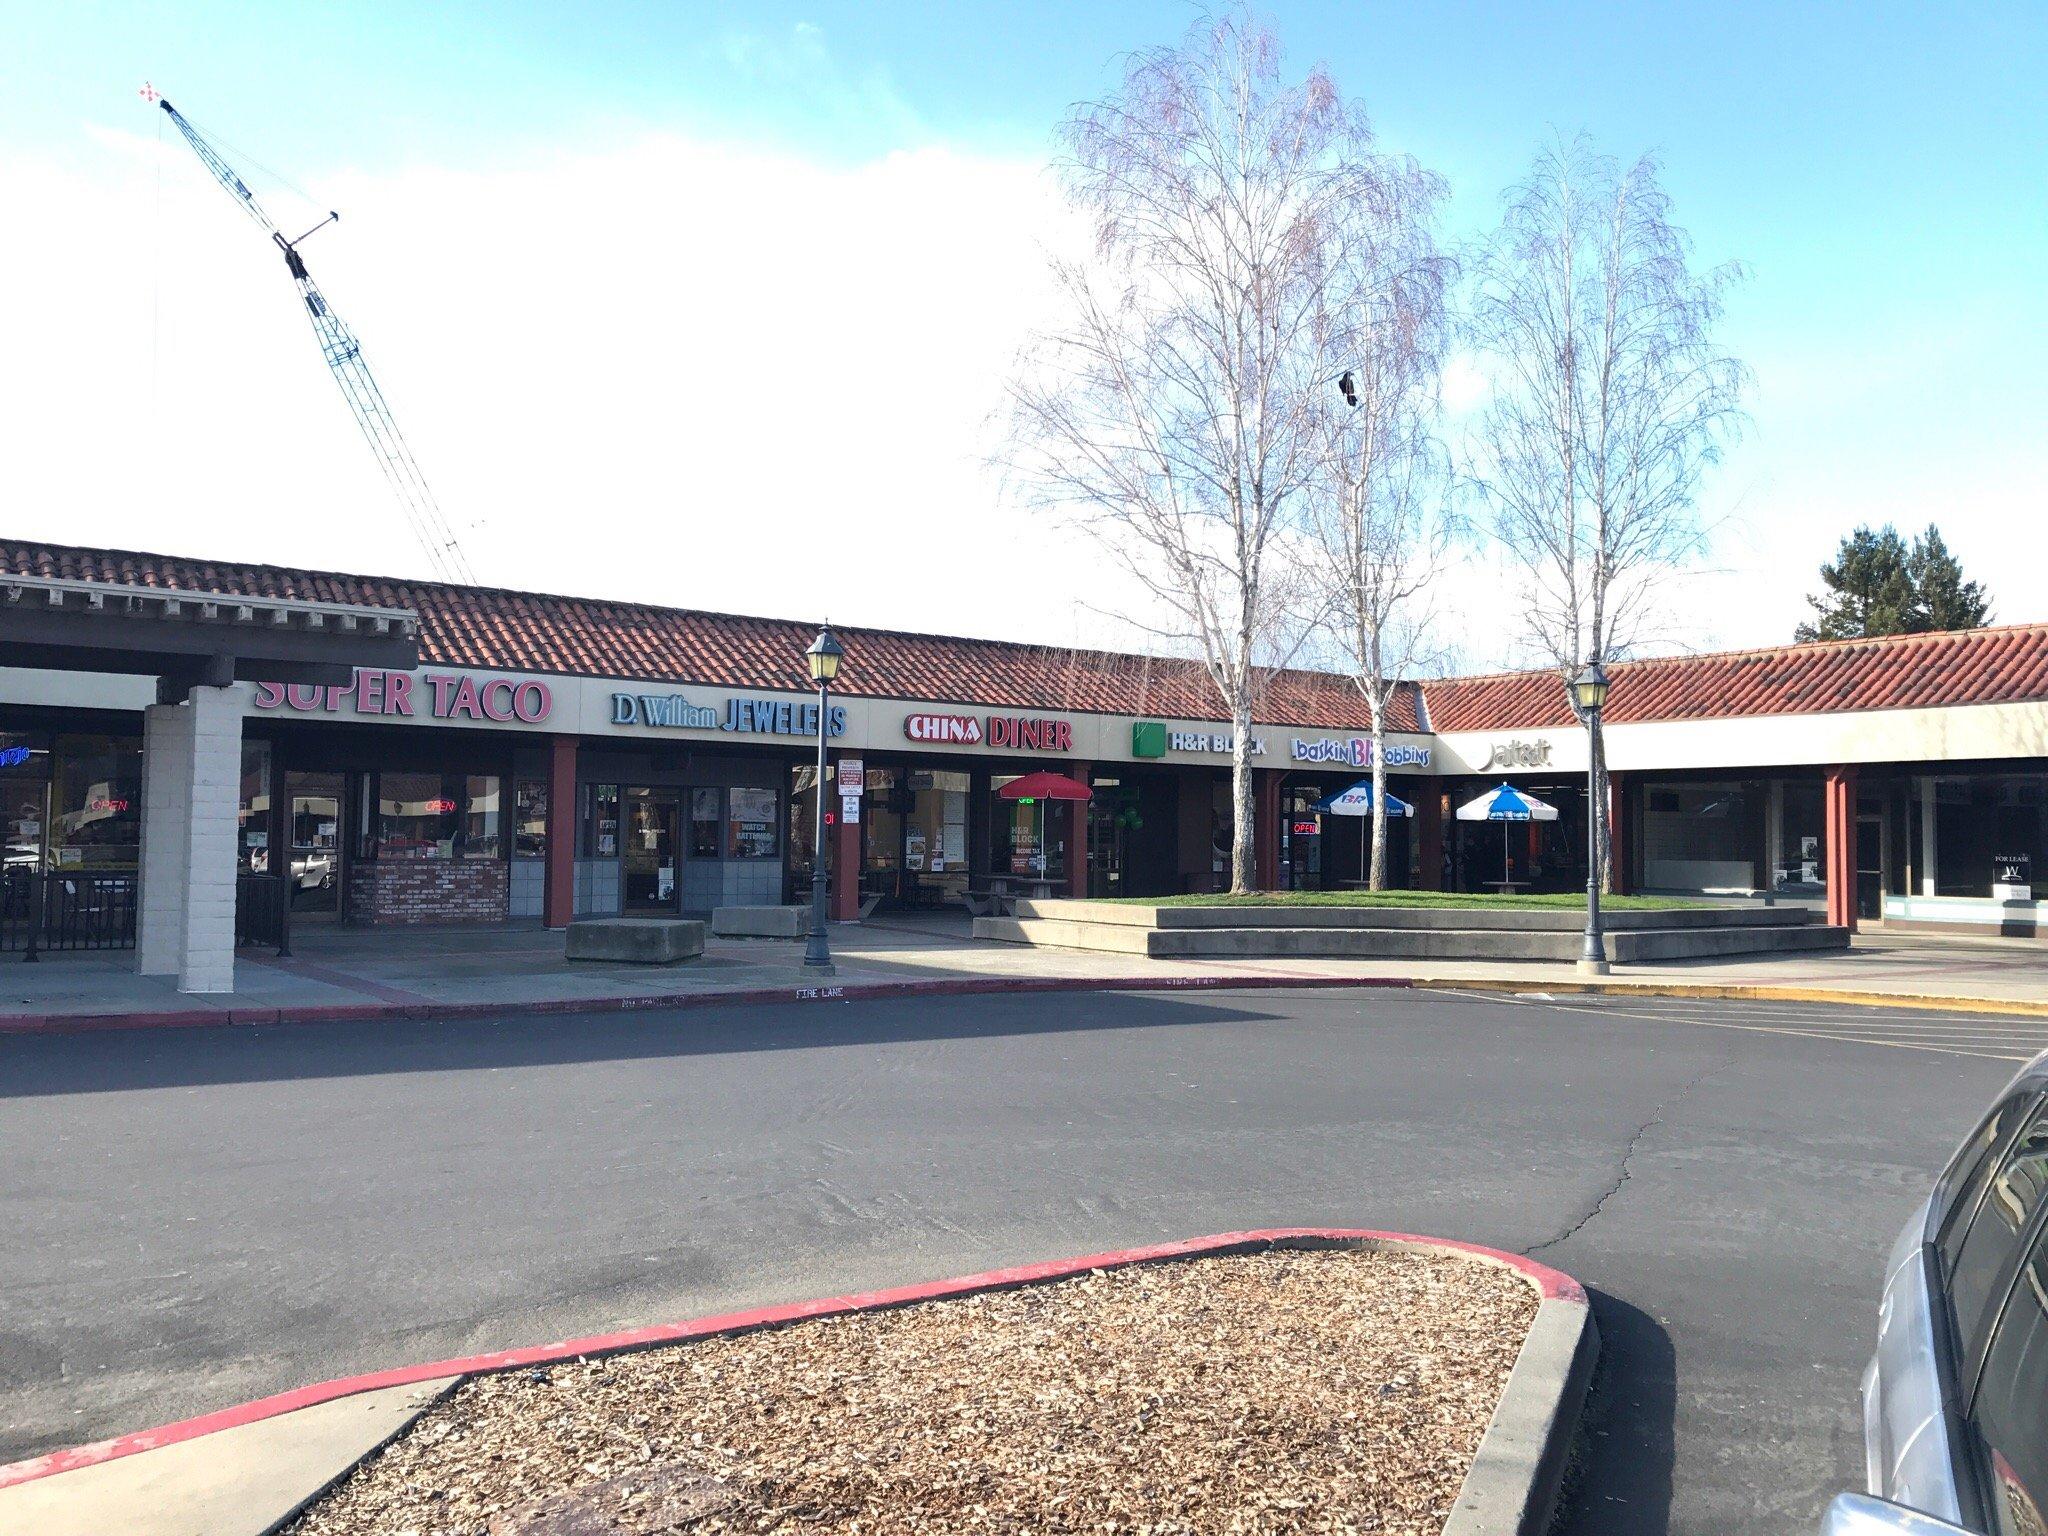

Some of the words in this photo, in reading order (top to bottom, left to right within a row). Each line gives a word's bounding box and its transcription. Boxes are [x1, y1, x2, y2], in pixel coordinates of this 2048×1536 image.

[426, 673, 553, 723] TACO
[612, 693, 638, 724] D.
[639, 694, 717, 729] William
[909, 716, 981, 742] CHINA
[986, 716, 1073, 751] DINER
[1171, 733, 1209, 751] H&R
[1213, 736, 1268, 755] BLK
[1295, 739, 1350, 764] baskin
[1384, 746, 1430, 767] obbins
[424, 800, 456, 812] OPEN
[1011, 835, 1039, 843] BLOCK
[1293, 824, 1316, 834] OPEN
[796, 989, 818, 998] FIRE
[822, 987, 844, 998] LANE
